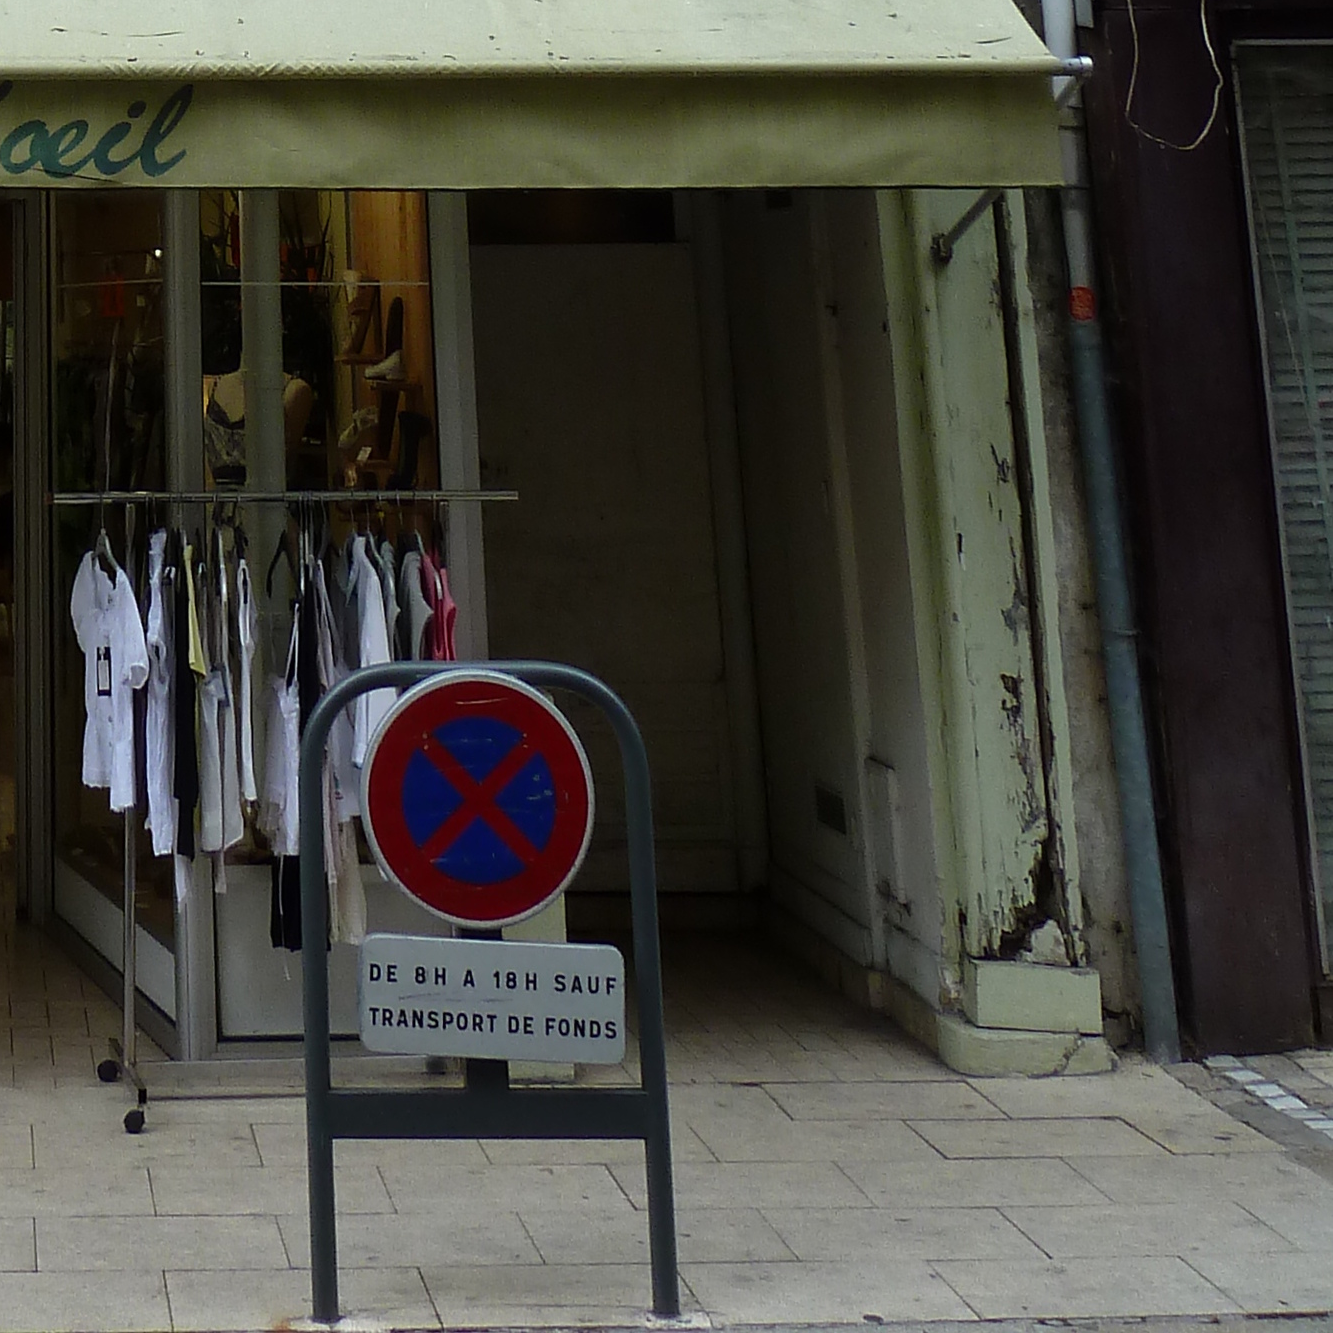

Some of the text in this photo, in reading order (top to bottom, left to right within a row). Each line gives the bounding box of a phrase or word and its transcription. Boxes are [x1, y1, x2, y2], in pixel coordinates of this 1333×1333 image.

[369, 963, 398, 983] DE
[463, 969, 476, 988] A
[554, 974, 618, 996] SAUF
[369, 1007, 618, 1040] TRANSPORT DE FONDS
